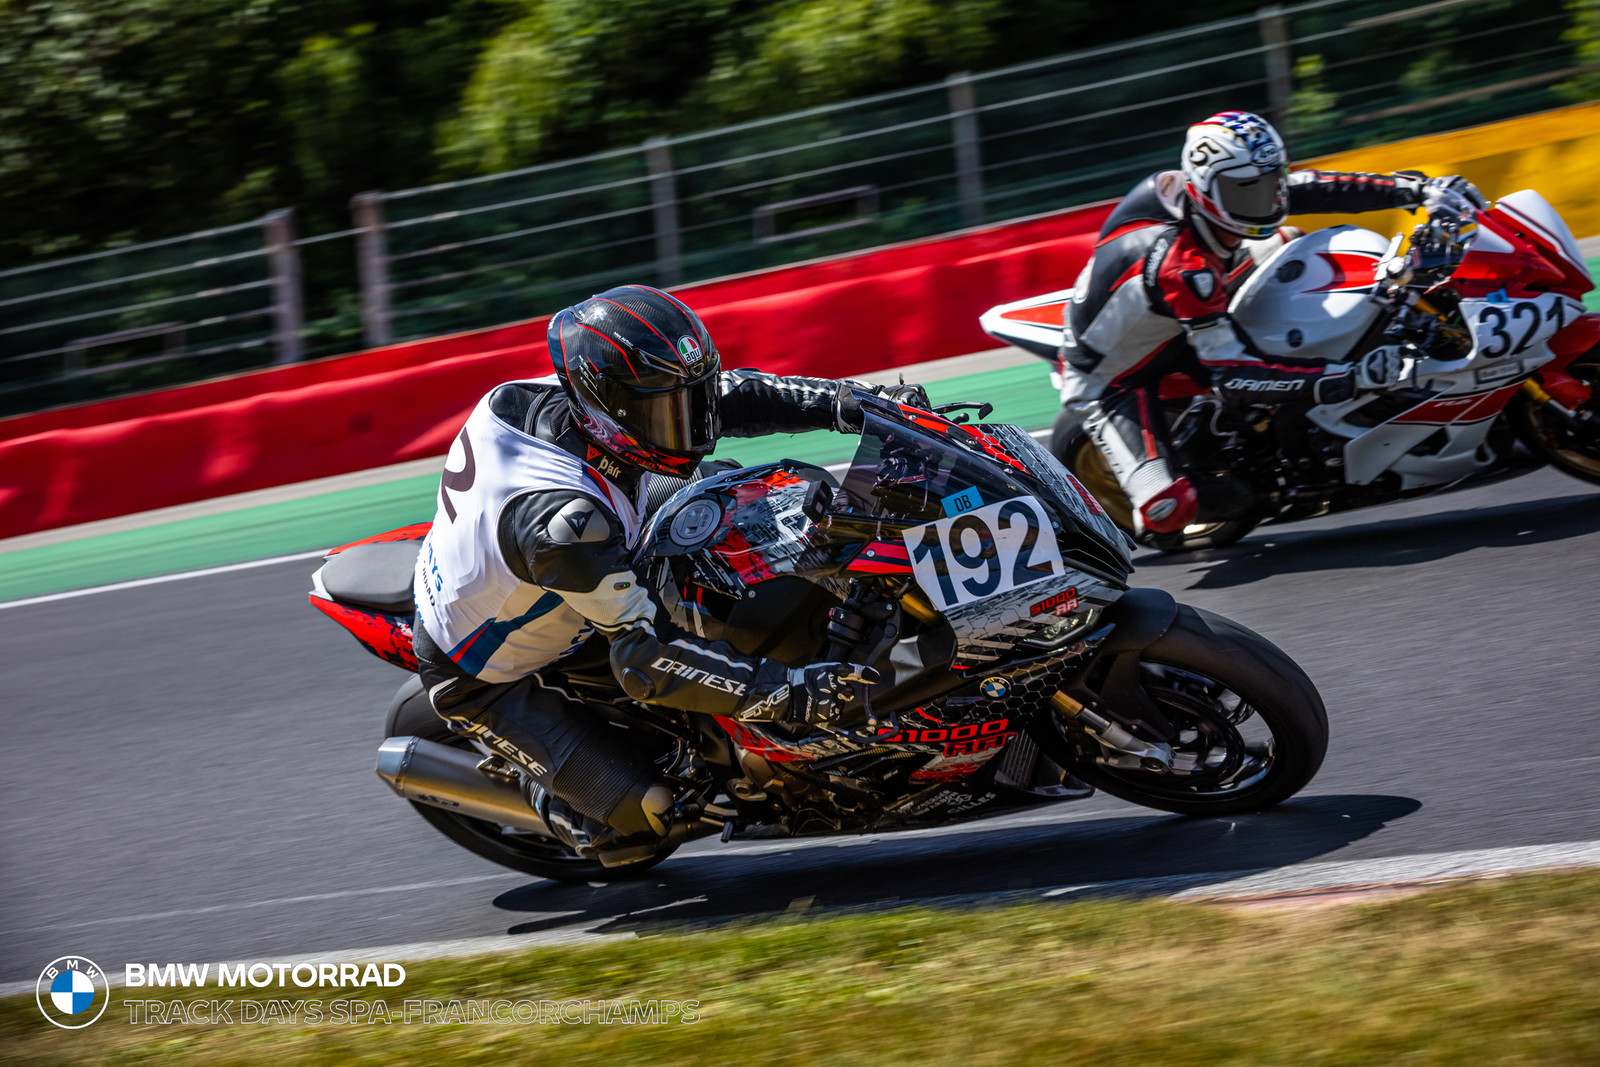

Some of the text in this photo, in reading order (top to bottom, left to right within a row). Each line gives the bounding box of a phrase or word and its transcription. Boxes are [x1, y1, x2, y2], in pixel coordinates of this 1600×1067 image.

[1479, 297, 1566, 358] 321
[441, 426, 476, 525] 2
[953, 494, 972, 513] DB
[913, 501, 1054, 606] 192
[1030, 588, 1076, 615] S1000
[650, 656, 747, 697] DAINESE
